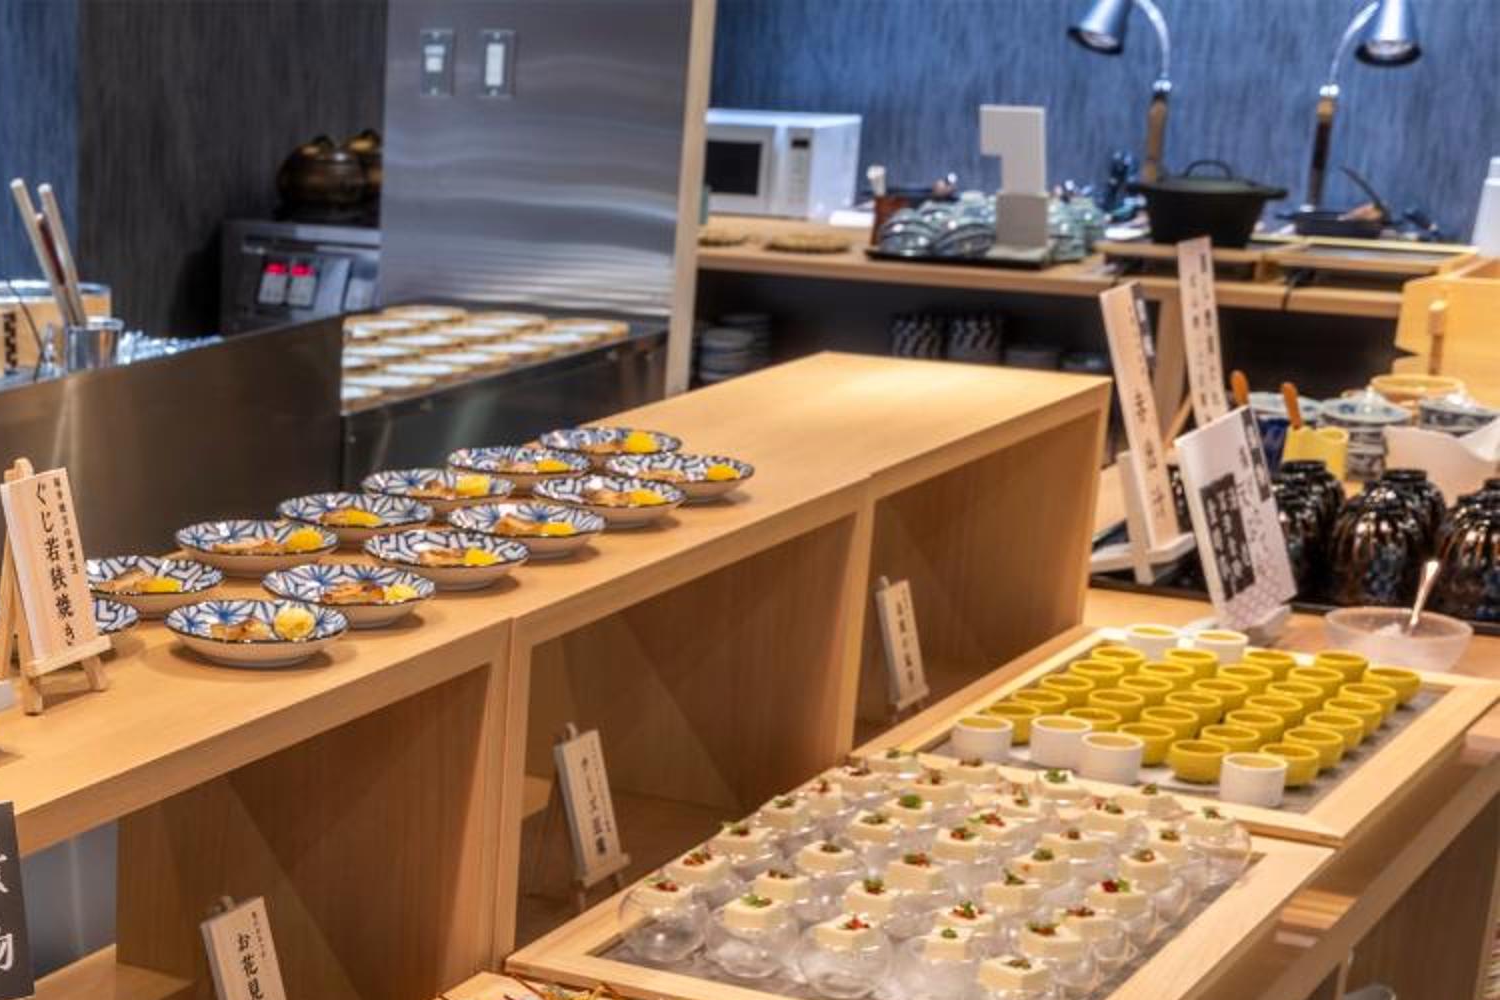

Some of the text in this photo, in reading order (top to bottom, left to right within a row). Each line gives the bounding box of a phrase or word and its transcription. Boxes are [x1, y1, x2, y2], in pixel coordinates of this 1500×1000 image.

[35, 481, 75, 647] ぐじ若狭焼き
